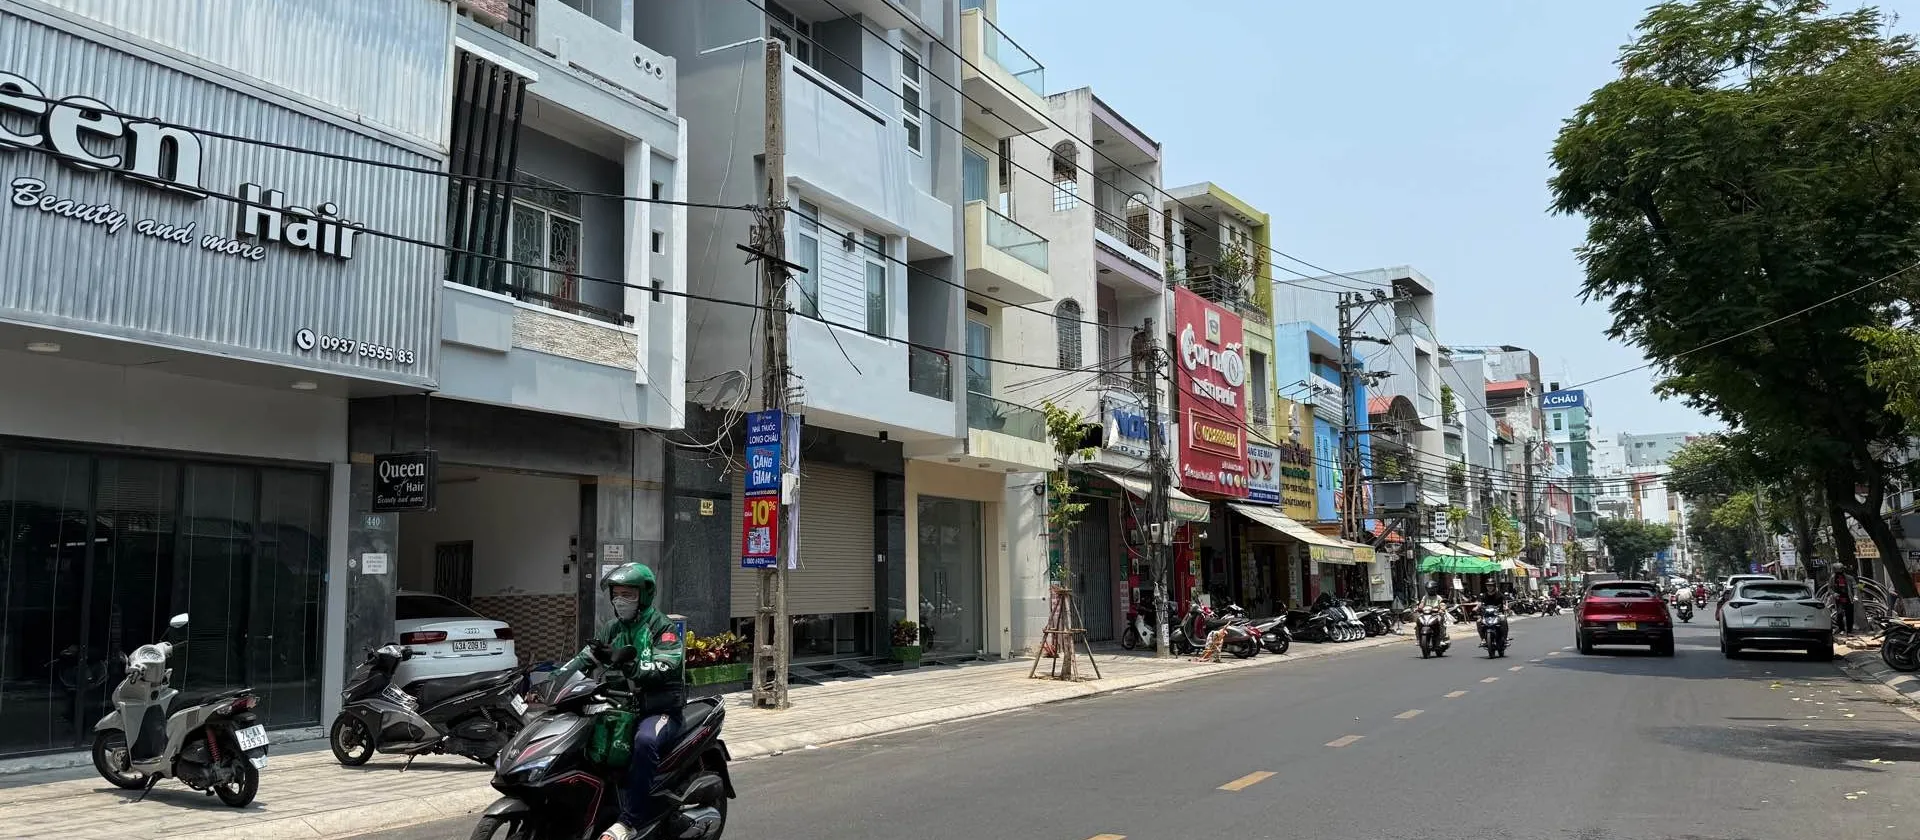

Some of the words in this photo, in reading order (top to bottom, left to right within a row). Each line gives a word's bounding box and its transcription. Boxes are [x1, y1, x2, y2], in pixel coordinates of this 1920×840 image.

[11, 176, 128, 235] Beauty
[136, 218, 197, 245] and
[202, 233, 266, 261] more
[239, 182, 365, 260] Hair
[320, 335, 356, 354] 0937
[359, 342, 394, 361] 5555
[398, 349, 414, 364] 83
[1551, 394, 1577, 404] CHÂU
[761, 422, 776, 432] THUỐC
[749, 435, 764, 445] LONG
[764, 432, 779, 443] CHÂU
[379, 460, 425, 483] Queen
[406, 482, 425, 493] Hair
[377, 494, 397, 505] Beauty
[366, 516, 382, 527] 440
